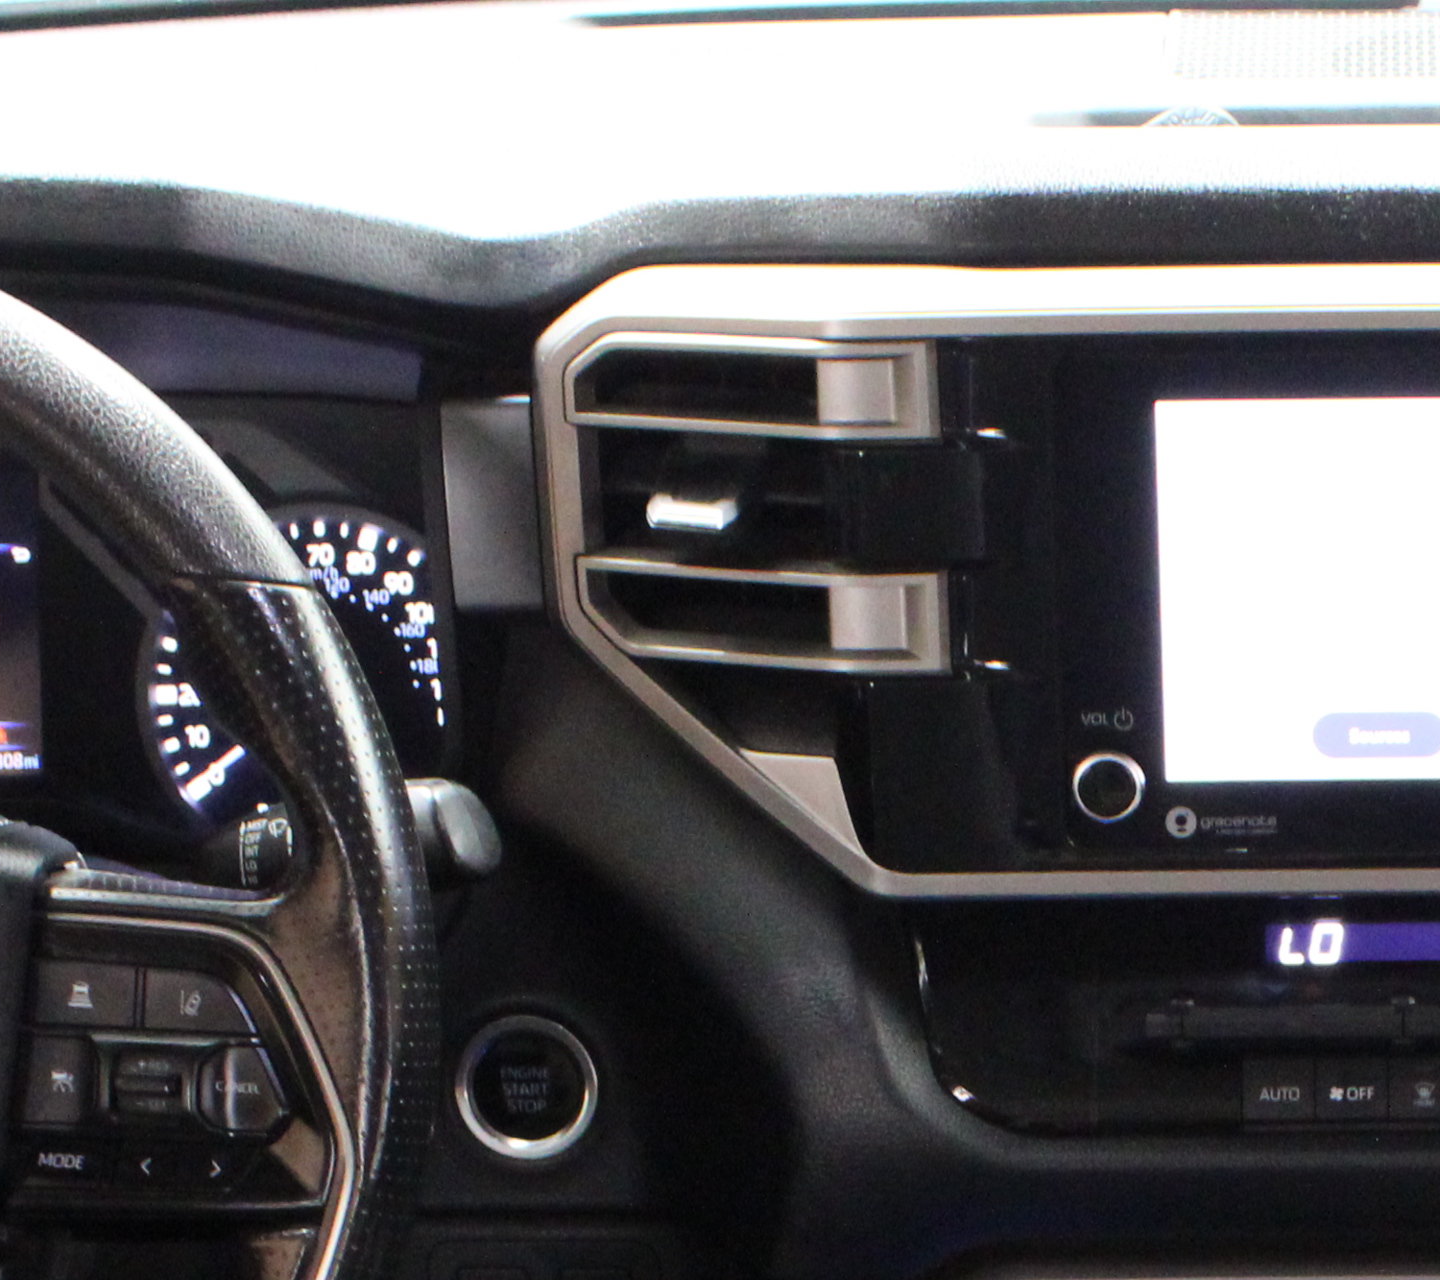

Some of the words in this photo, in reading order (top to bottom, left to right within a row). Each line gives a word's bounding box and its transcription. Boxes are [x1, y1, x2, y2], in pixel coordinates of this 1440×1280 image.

[306, 543, 336, 567] 70
[346, 551, 376, 576] 80
[383, 571, 414, 596] 90
[362, 588, 391, 606] 140
[1080, 710, 1110, 727] VOL
[184, 724, 210, 749] 10
[1278, 921, 1346, 966] LO
[499, 1065, 551, 1080] ENGINE
[502, 1081, 550, 1097] START
[1259, 1086, 1301, 1102] AUTO
[1346, 1086, 1376, 1102] OFF
[505, 1098, 547, 1114] STOP
[37, 1151, 85, 1171] MODE
